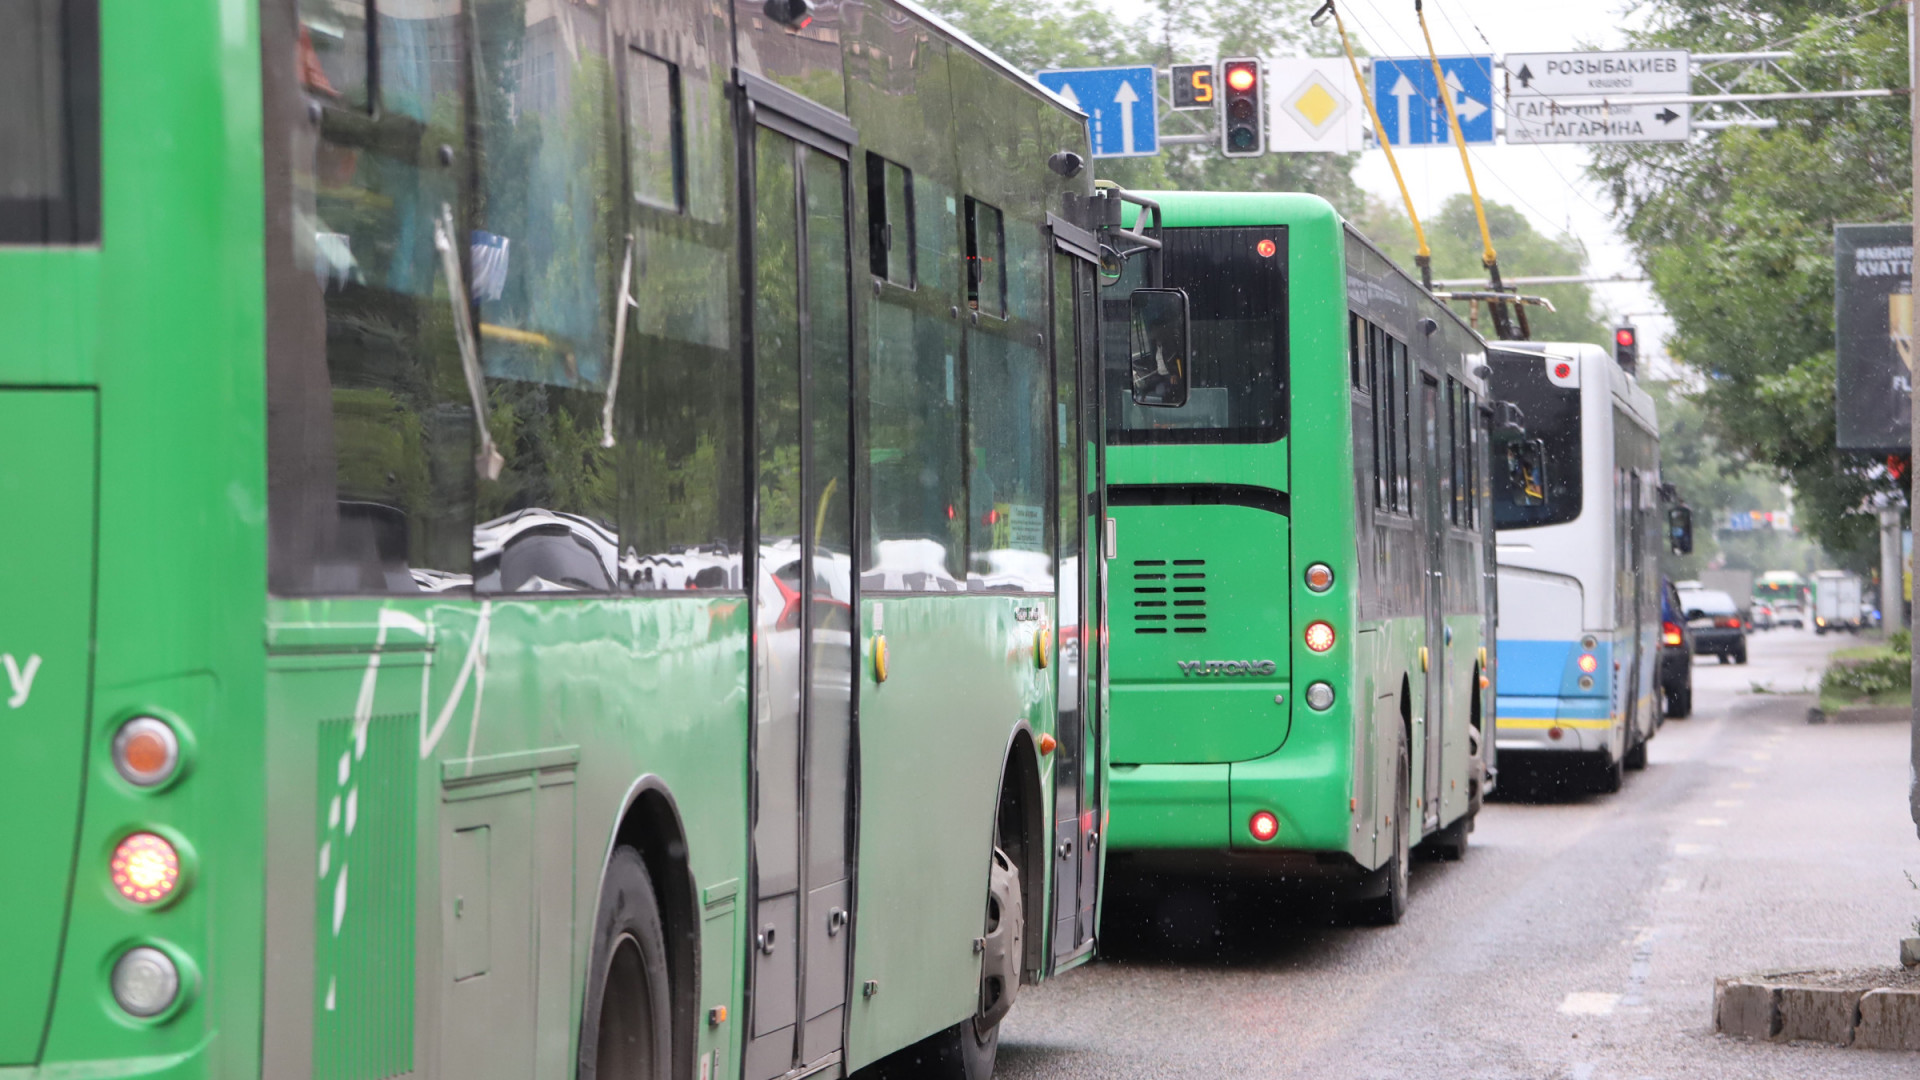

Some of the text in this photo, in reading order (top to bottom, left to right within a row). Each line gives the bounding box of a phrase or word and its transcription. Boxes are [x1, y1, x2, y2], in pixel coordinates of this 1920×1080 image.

[1547, 58, 1677, 75] РОЗЫБАКИЕВ
[1192, 70, 1213, 102] 5
[1543, 121, 1643, 137] ГАГАРИНА
[1177, 659, 1277, 677] YUTONG
